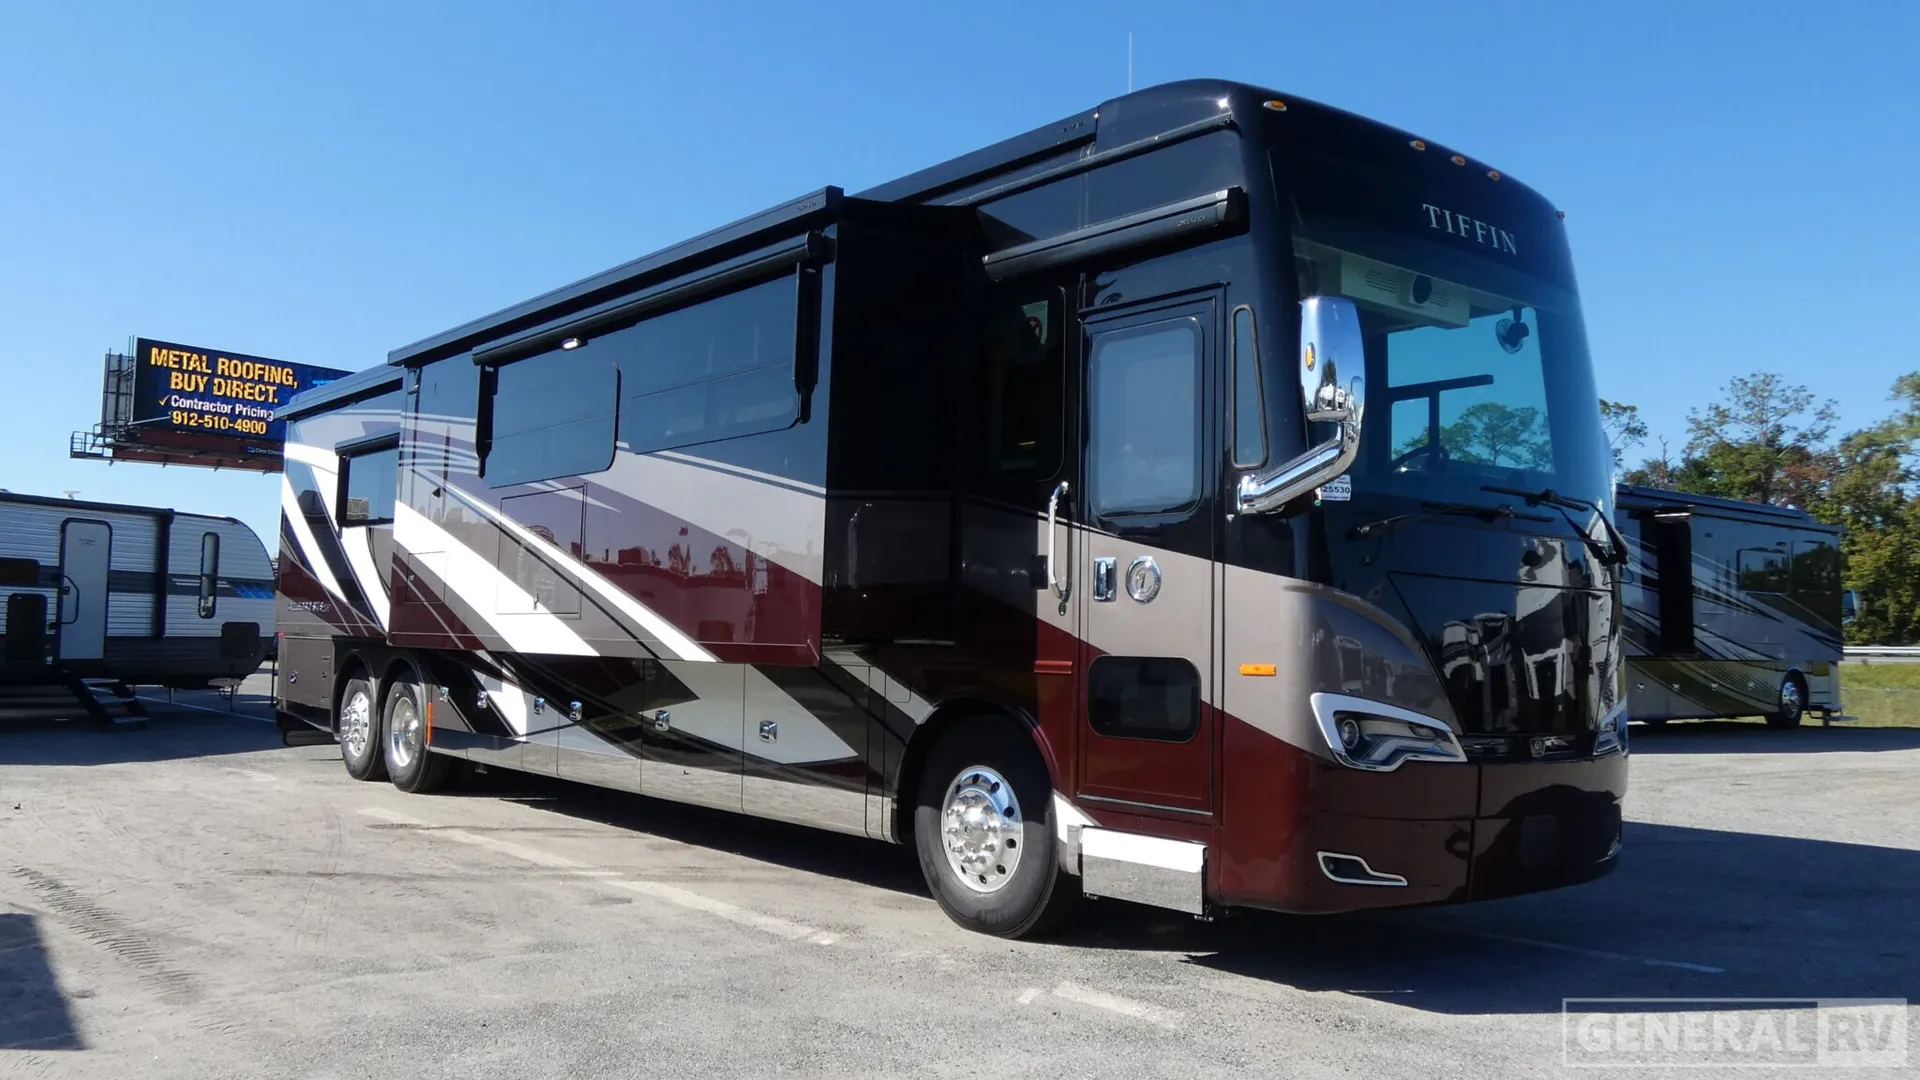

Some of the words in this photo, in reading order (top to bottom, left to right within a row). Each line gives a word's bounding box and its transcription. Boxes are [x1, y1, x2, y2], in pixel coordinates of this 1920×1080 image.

[1423, 203, 1517, 256] TIFFIN
[151, 347, 212, 374] METAL
[217, 357, 298, 389] ROOFING,
[170, 371, 209, 393] BUY
[213, 378, 279, 403] DIRECT.
[171, 394, 233, 414] Contractor
[235, 403, 274, 421] Pricing
[172, 411, 267, 434] 912-510-4900
